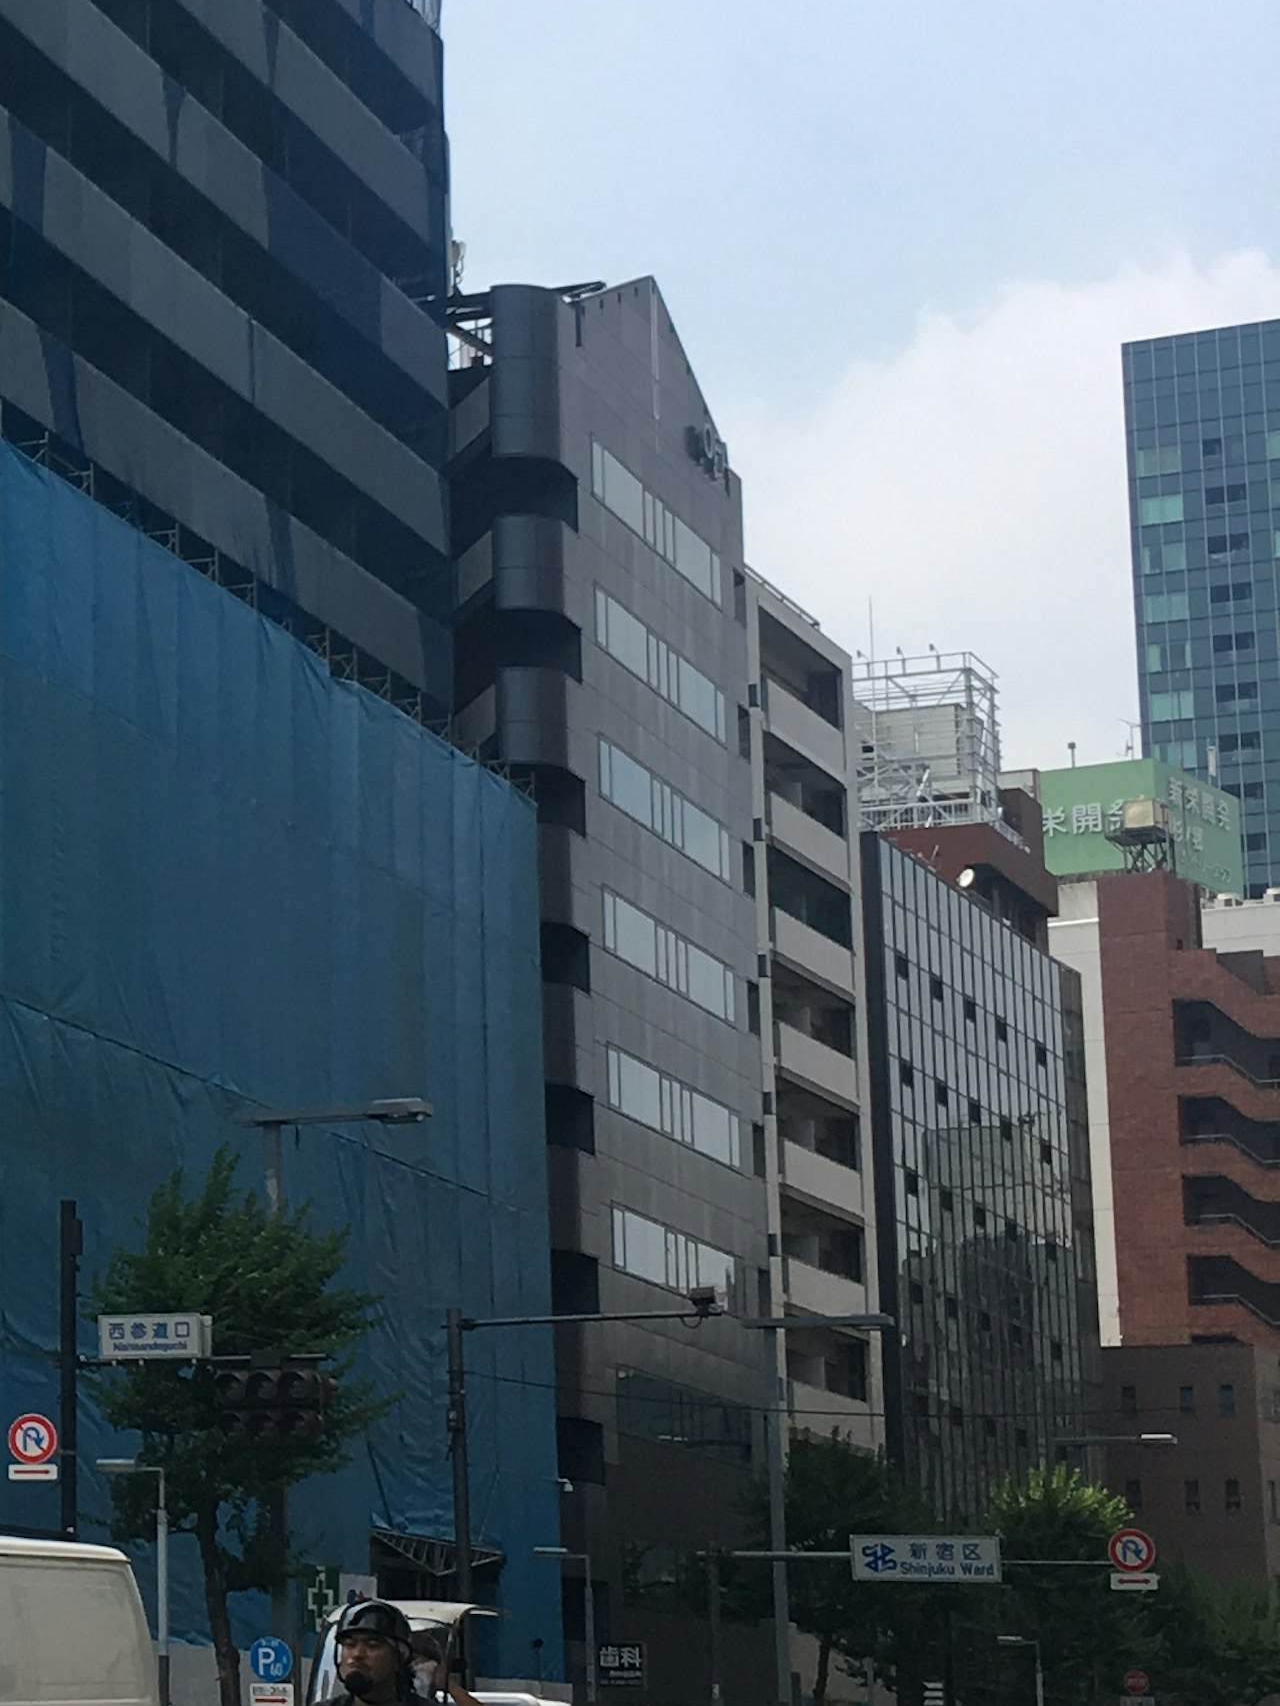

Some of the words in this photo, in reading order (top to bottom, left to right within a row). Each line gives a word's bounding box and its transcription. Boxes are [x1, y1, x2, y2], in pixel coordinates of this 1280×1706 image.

[108, 1321, 190, 1340] 西参道口
[909, 1543, 981, 1560] 新宿区
[900, 1562, 955, 1577] Shinjuku
[960, 1563, 994, 1576] Ward
[599, 1646, 642, 1667] 歯科
